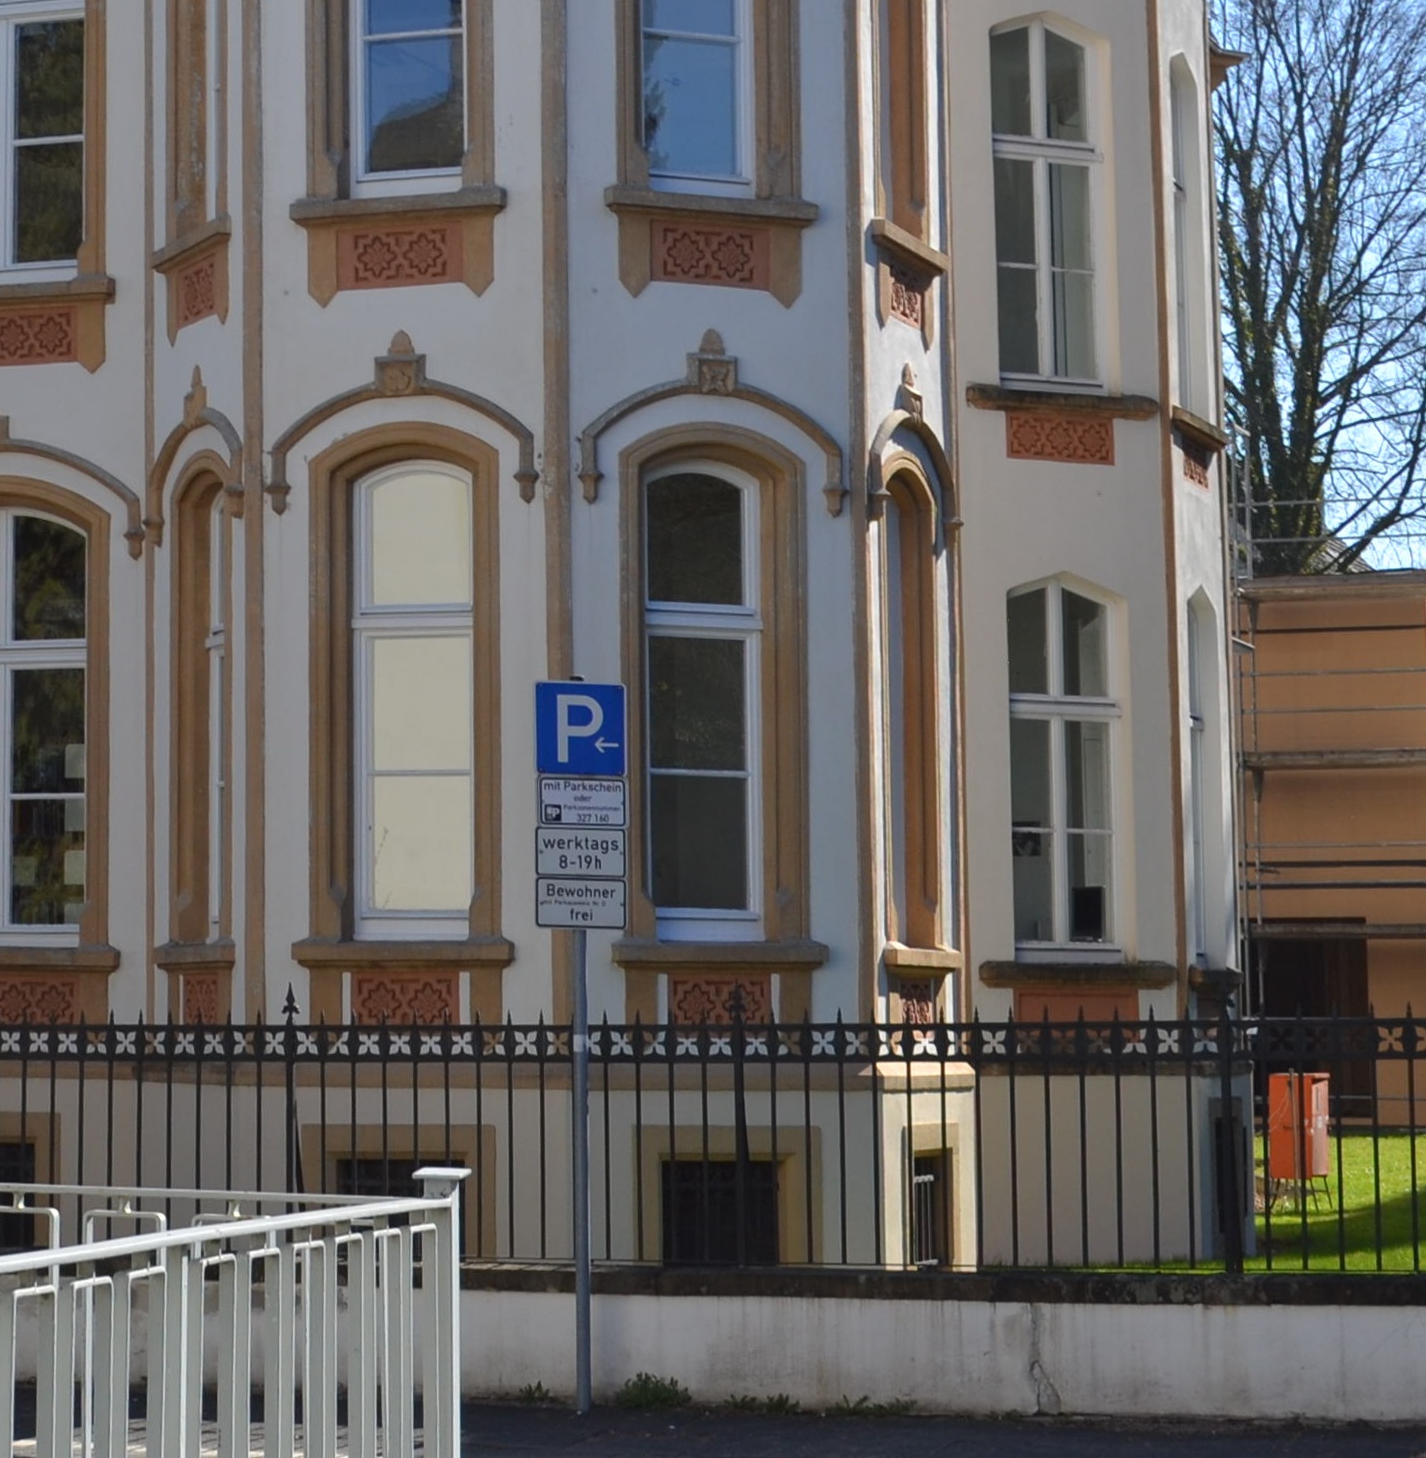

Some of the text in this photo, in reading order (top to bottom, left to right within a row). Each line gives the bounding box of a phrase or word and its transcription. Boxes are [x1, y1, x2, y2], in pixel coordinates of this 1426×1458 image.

[557, 694, 604, 763] P
[544, 781, 622, 793] mit Parkschein
[573, 794, 592, 803] oder
[542, 835, 619, 855] werktags
[546, 883, 616, 899] Bewohner
[570, 907, 593, 921] frei
